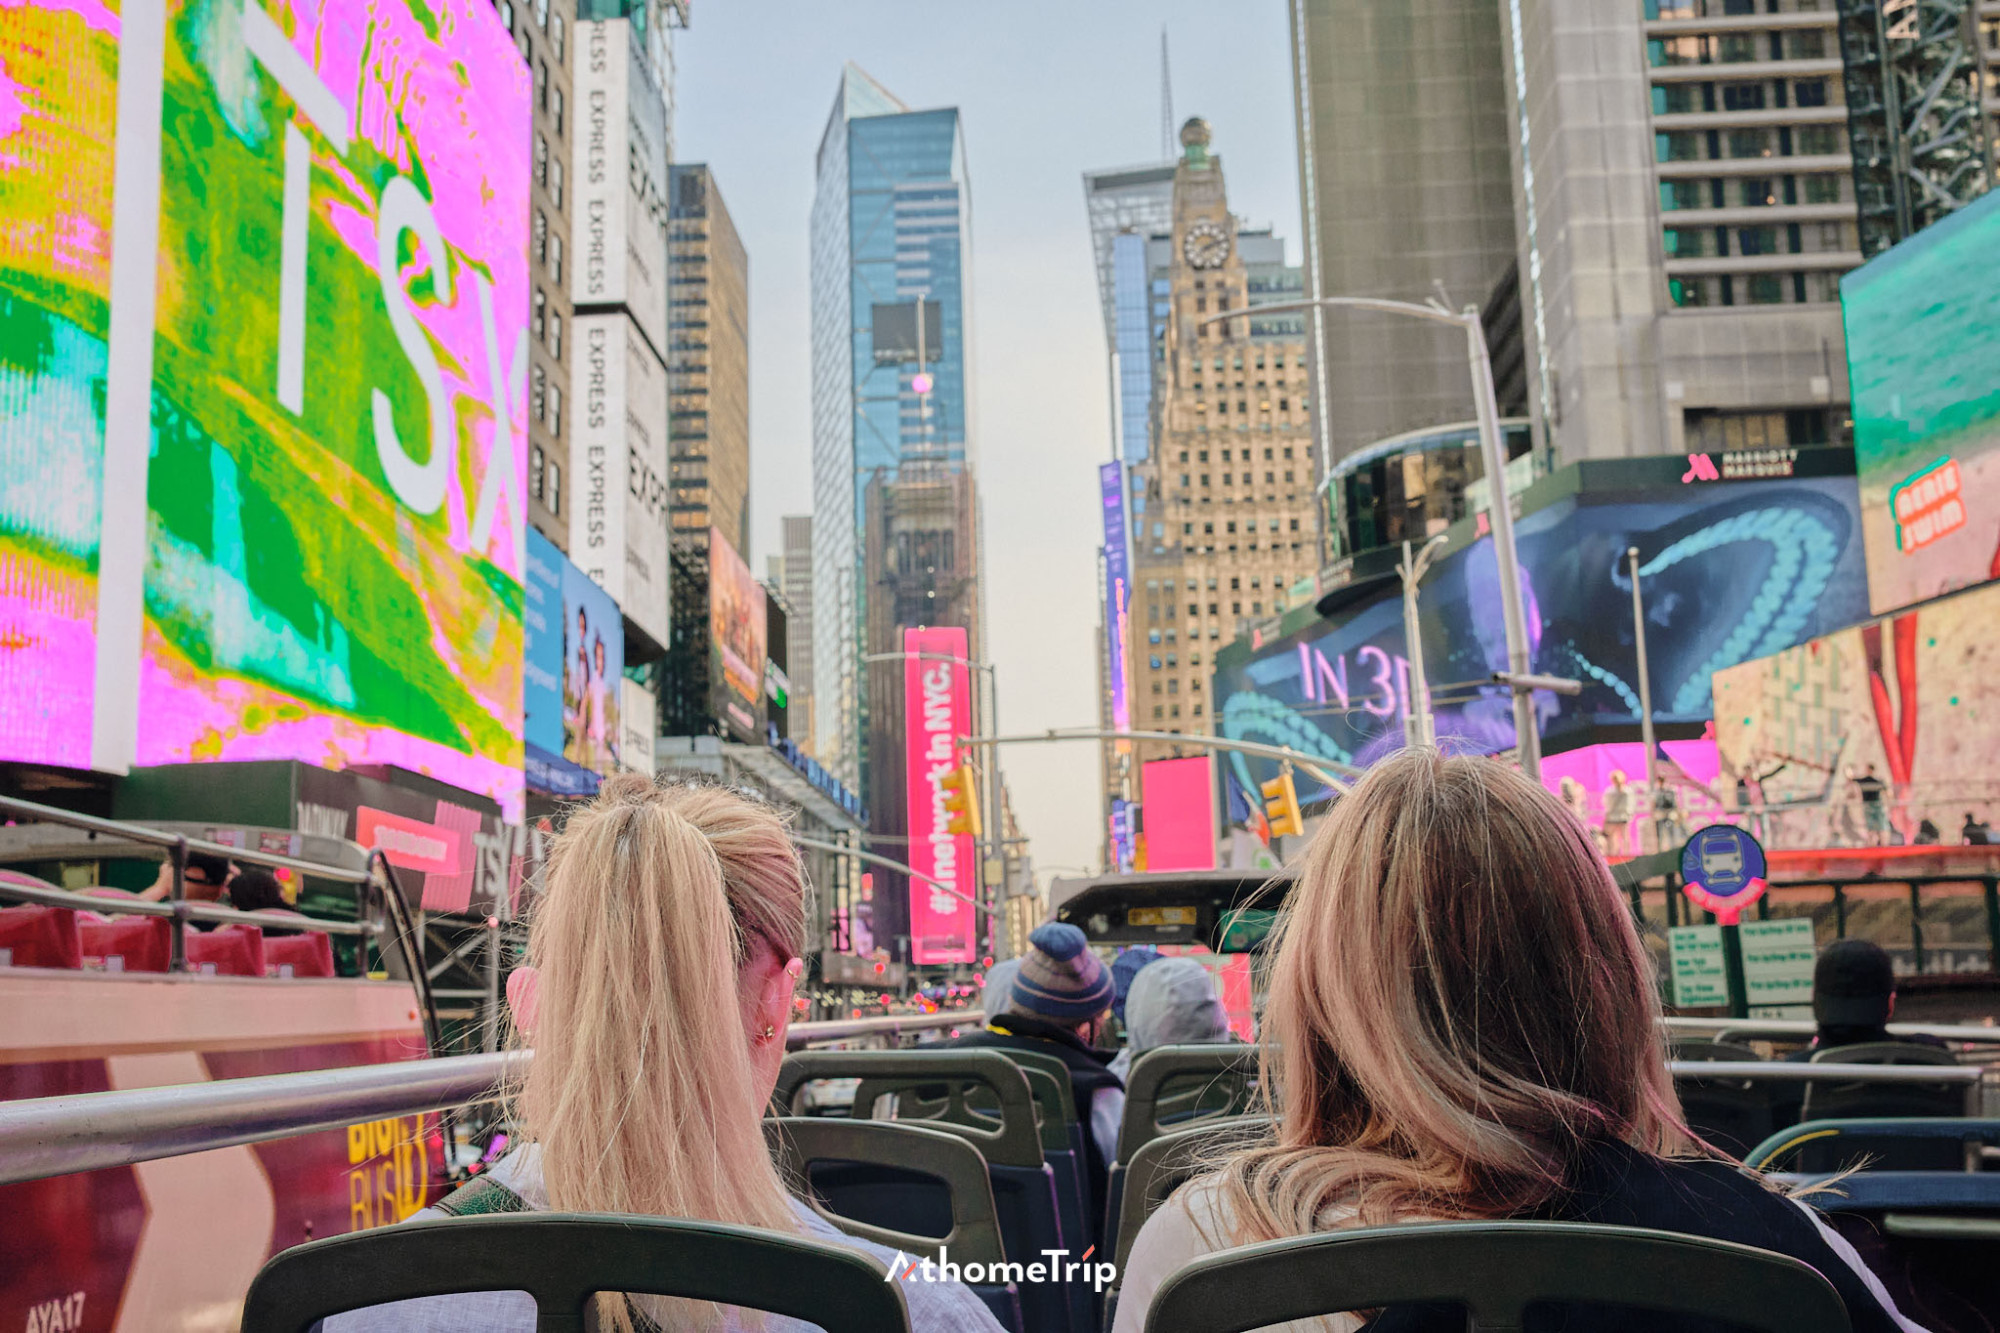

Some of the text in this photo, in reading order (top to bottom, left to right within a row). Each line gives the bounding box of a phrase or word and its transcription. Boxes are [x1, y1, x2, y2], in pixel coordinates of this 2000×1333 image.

[589, 90, 606, 184] EXPRESS
[588, 200, 605, 295] EXPRESS
[588, 328, 606, 429] EXPRESS
[587, 446, 605, 548] EXPRESS
[923, 662, 953, 732] NYC.
[1298, 640, 1350, 710] IN
[925, 733, 953, 760] in
